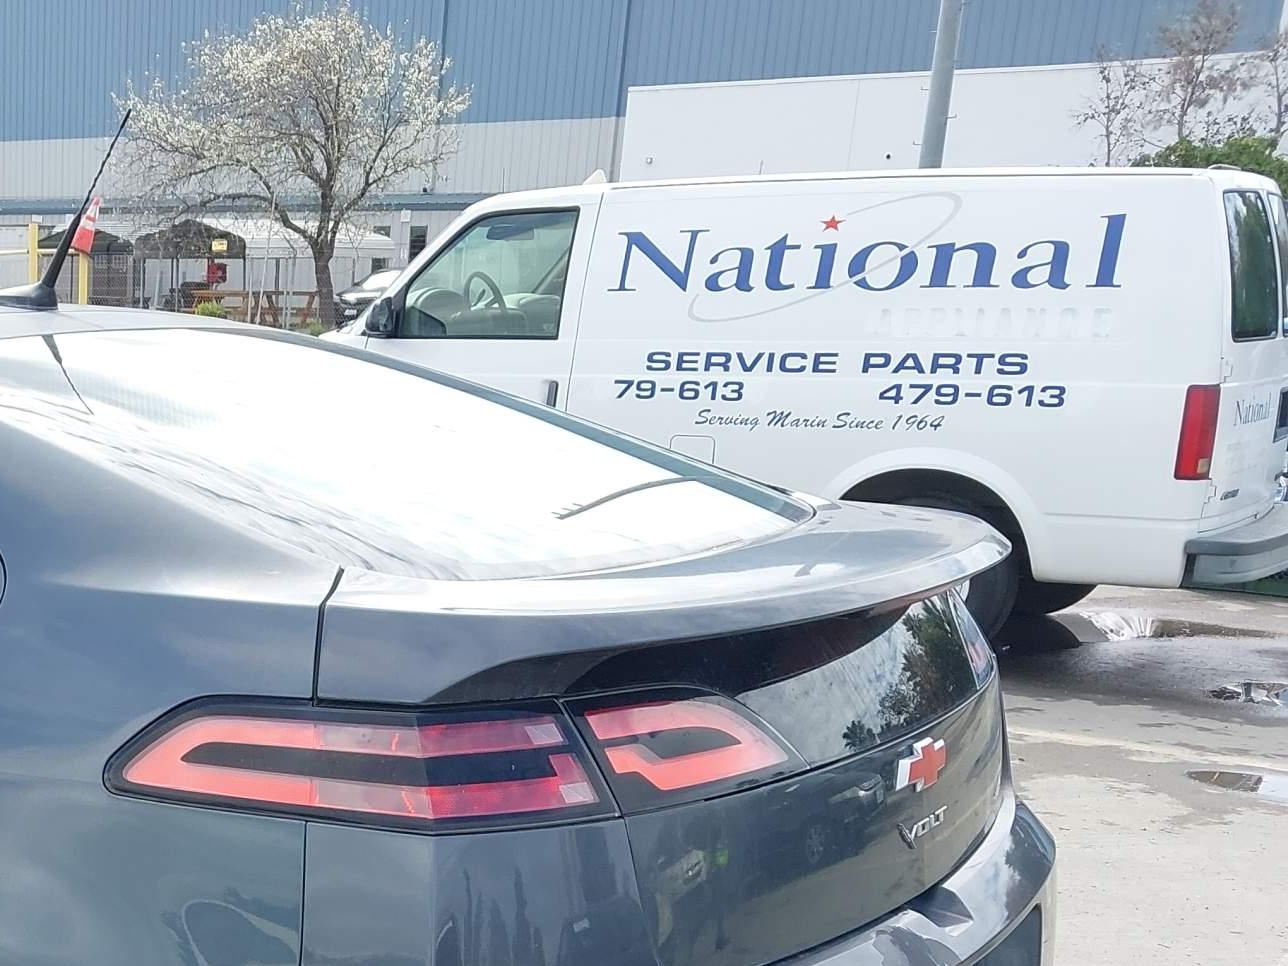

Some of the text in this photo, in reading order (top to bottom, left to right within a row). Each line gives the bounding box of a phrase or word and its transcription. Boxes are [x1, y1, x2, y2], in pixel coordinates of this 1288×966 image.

[608, 213, 1127, 293] National
[645, 351, 1029, 376] SERVICE PARTS
[614, 379, 745, 402] 79-613
[878, 383, 1066, 408] 479-613
[694, 408, 945, 432] Serving Marin Since 1964
[1233, 391, 1272, 427] National
[897, 805, 948, 849] VOLT
